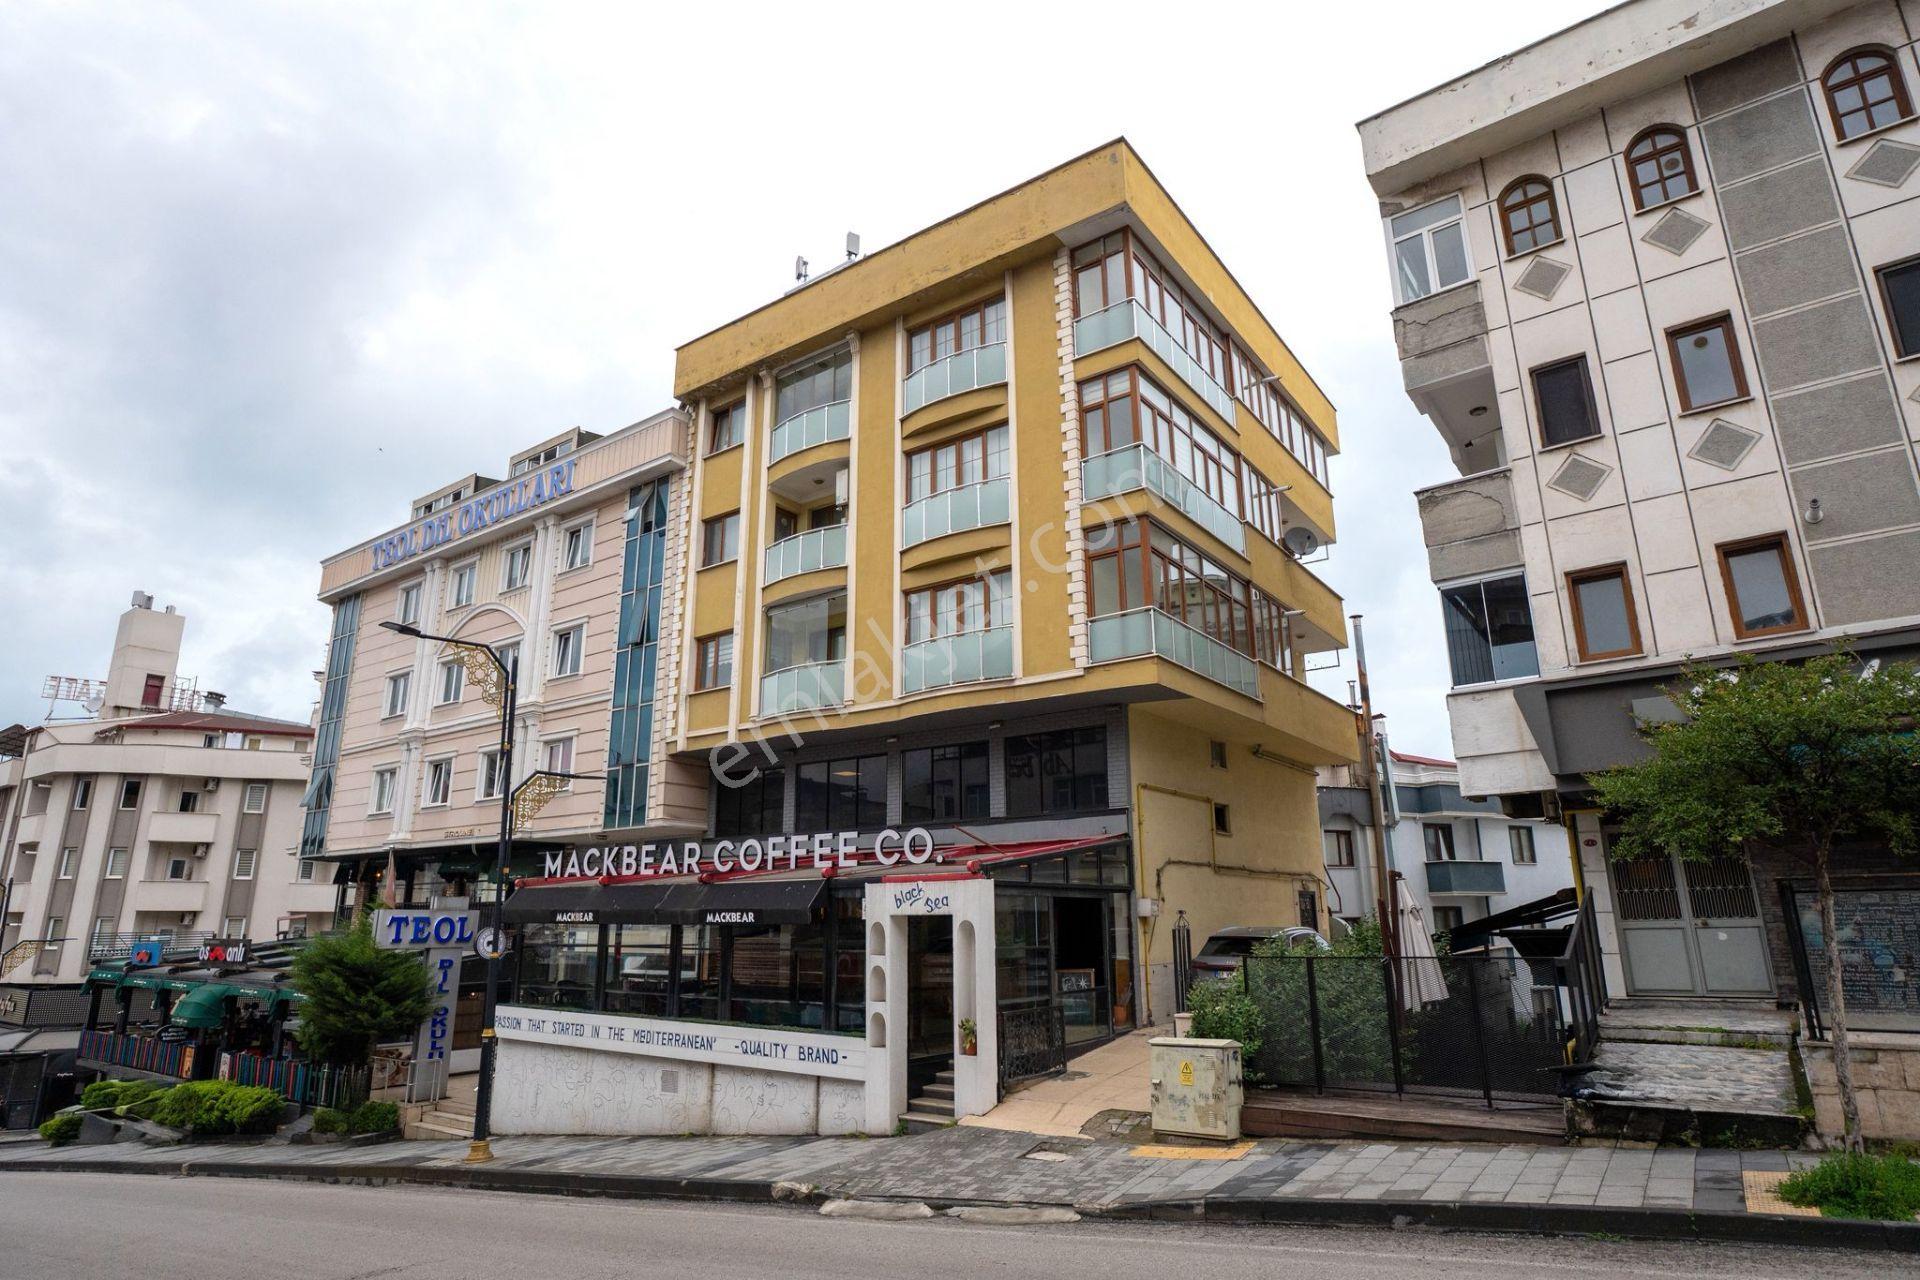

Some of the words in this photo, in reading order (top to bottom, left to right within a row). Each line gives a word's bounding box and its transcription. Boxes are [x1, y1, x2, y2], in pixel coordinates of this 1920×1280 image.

[372, 527, 420, 571] TEOL
[458, 459, 577, 537] OKULLARI
[544, 841, 701, 879] MACKBEAR
[713, 830, 859, 873] COFFEE
[874, 827, 945, 865] CO.
[894, 882, 926, 909] black
[924, 895, 949, 913] sea
[387, 915, 475, 945] TEOL
[556, 912, 594, 922] MACKBEAR
[706, 911, 755, 923] MACKBEAR
[527, 1018, 546, 1033] THAT
[552, 1021, 585, 1037] STARTED
[591, 1024, 600, 1038] IN
[608, 1026, 625, 1042] THE
